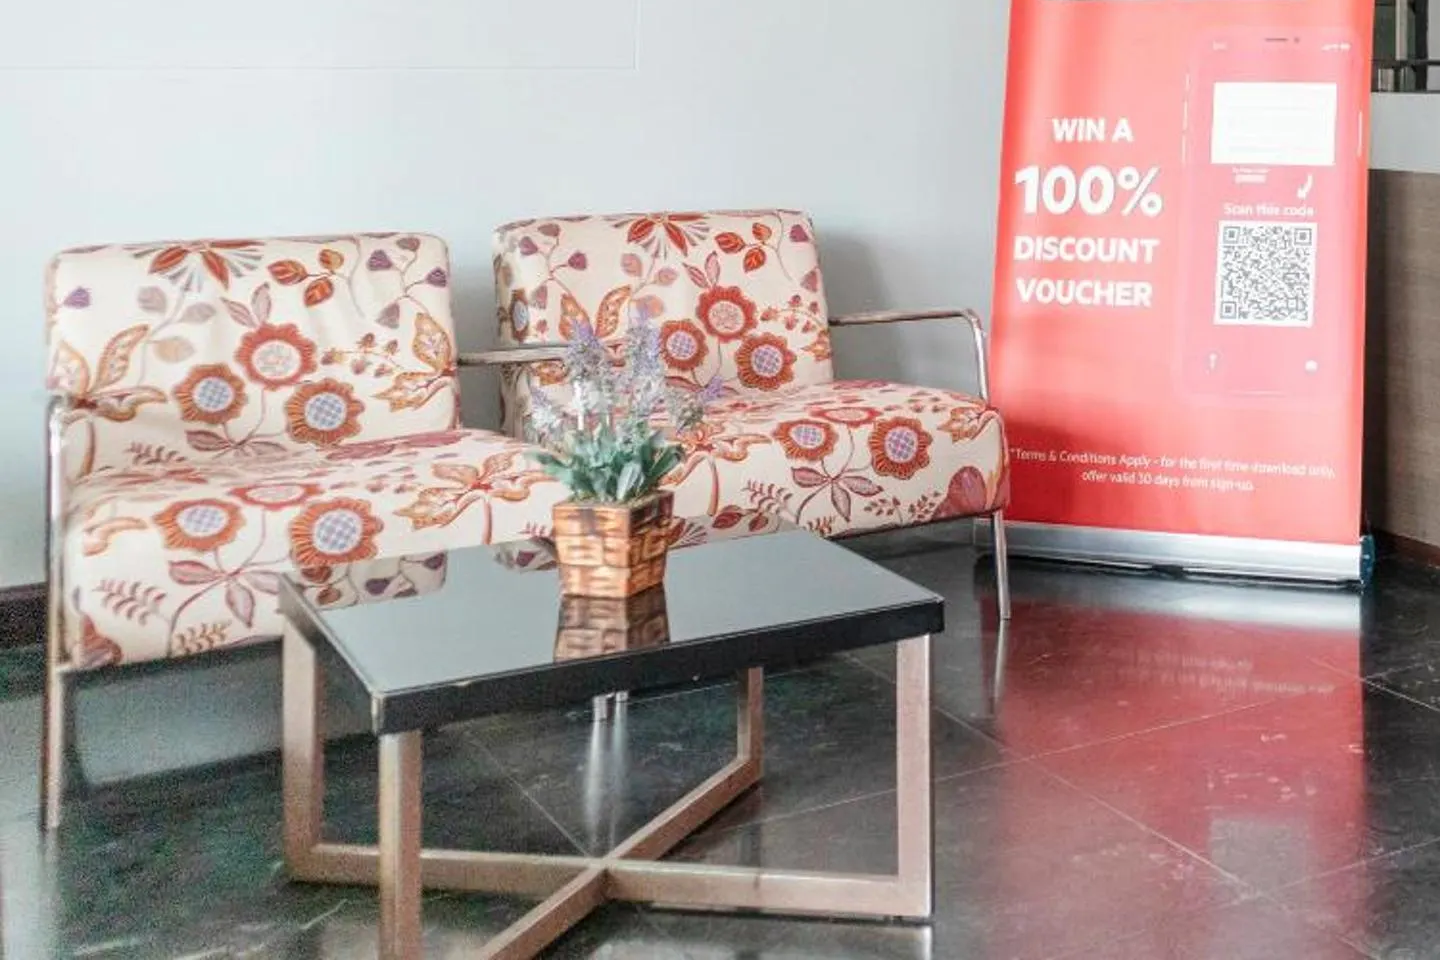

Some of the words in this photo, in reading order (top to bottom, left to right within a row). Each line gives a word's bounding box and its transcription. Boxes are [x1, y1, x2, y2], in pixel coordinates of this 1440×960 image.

[1051, 117, 1106, 143] WIN
[1111, 117, 1135, 143] A
[1014, 164, 1164, 218] 100%
[1223, 202, 1254, 217] Scan
[1013, 235, 1160, 264] DISCOUNT
[1015, 277, 1154, 308] VOUCHER
[1059, 449, 1117, 466] Conditions
[1118, 454, 1151, 469] Apply
[1160, 454, 1175, 468] for
[1179, 456, 1197, 470] the
[1081, 469, 1107, 483] offer
[1110, 470, 1136, 485] valid
[1153, 472, 1181, 490] days
[1182, 473, 1208, 488] from
